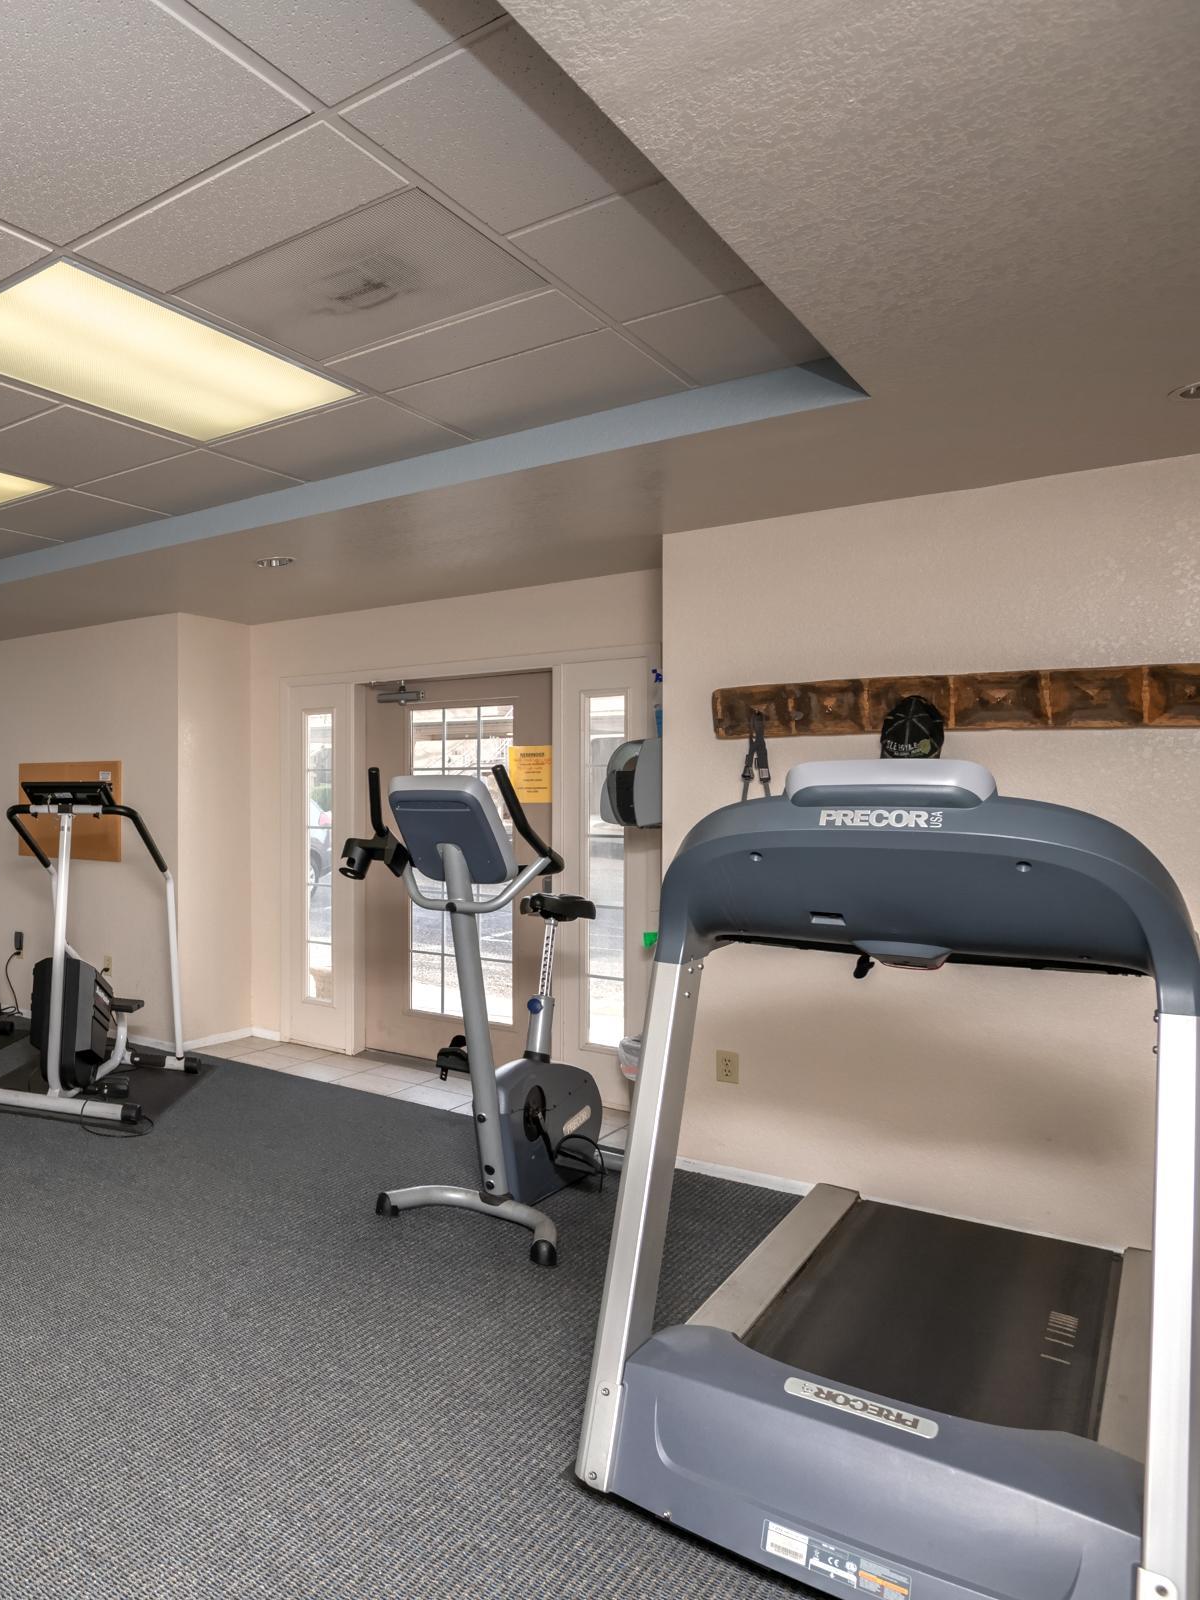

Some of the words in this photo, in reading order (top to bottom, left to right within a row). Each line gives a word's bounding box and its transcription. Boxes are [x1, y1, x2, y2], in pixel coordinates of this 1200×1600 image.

[819, 809, 928, 828] PRECOR
[929, 811, 943, 828] USA
[813, 1387, 920, 1429] PRECOR
